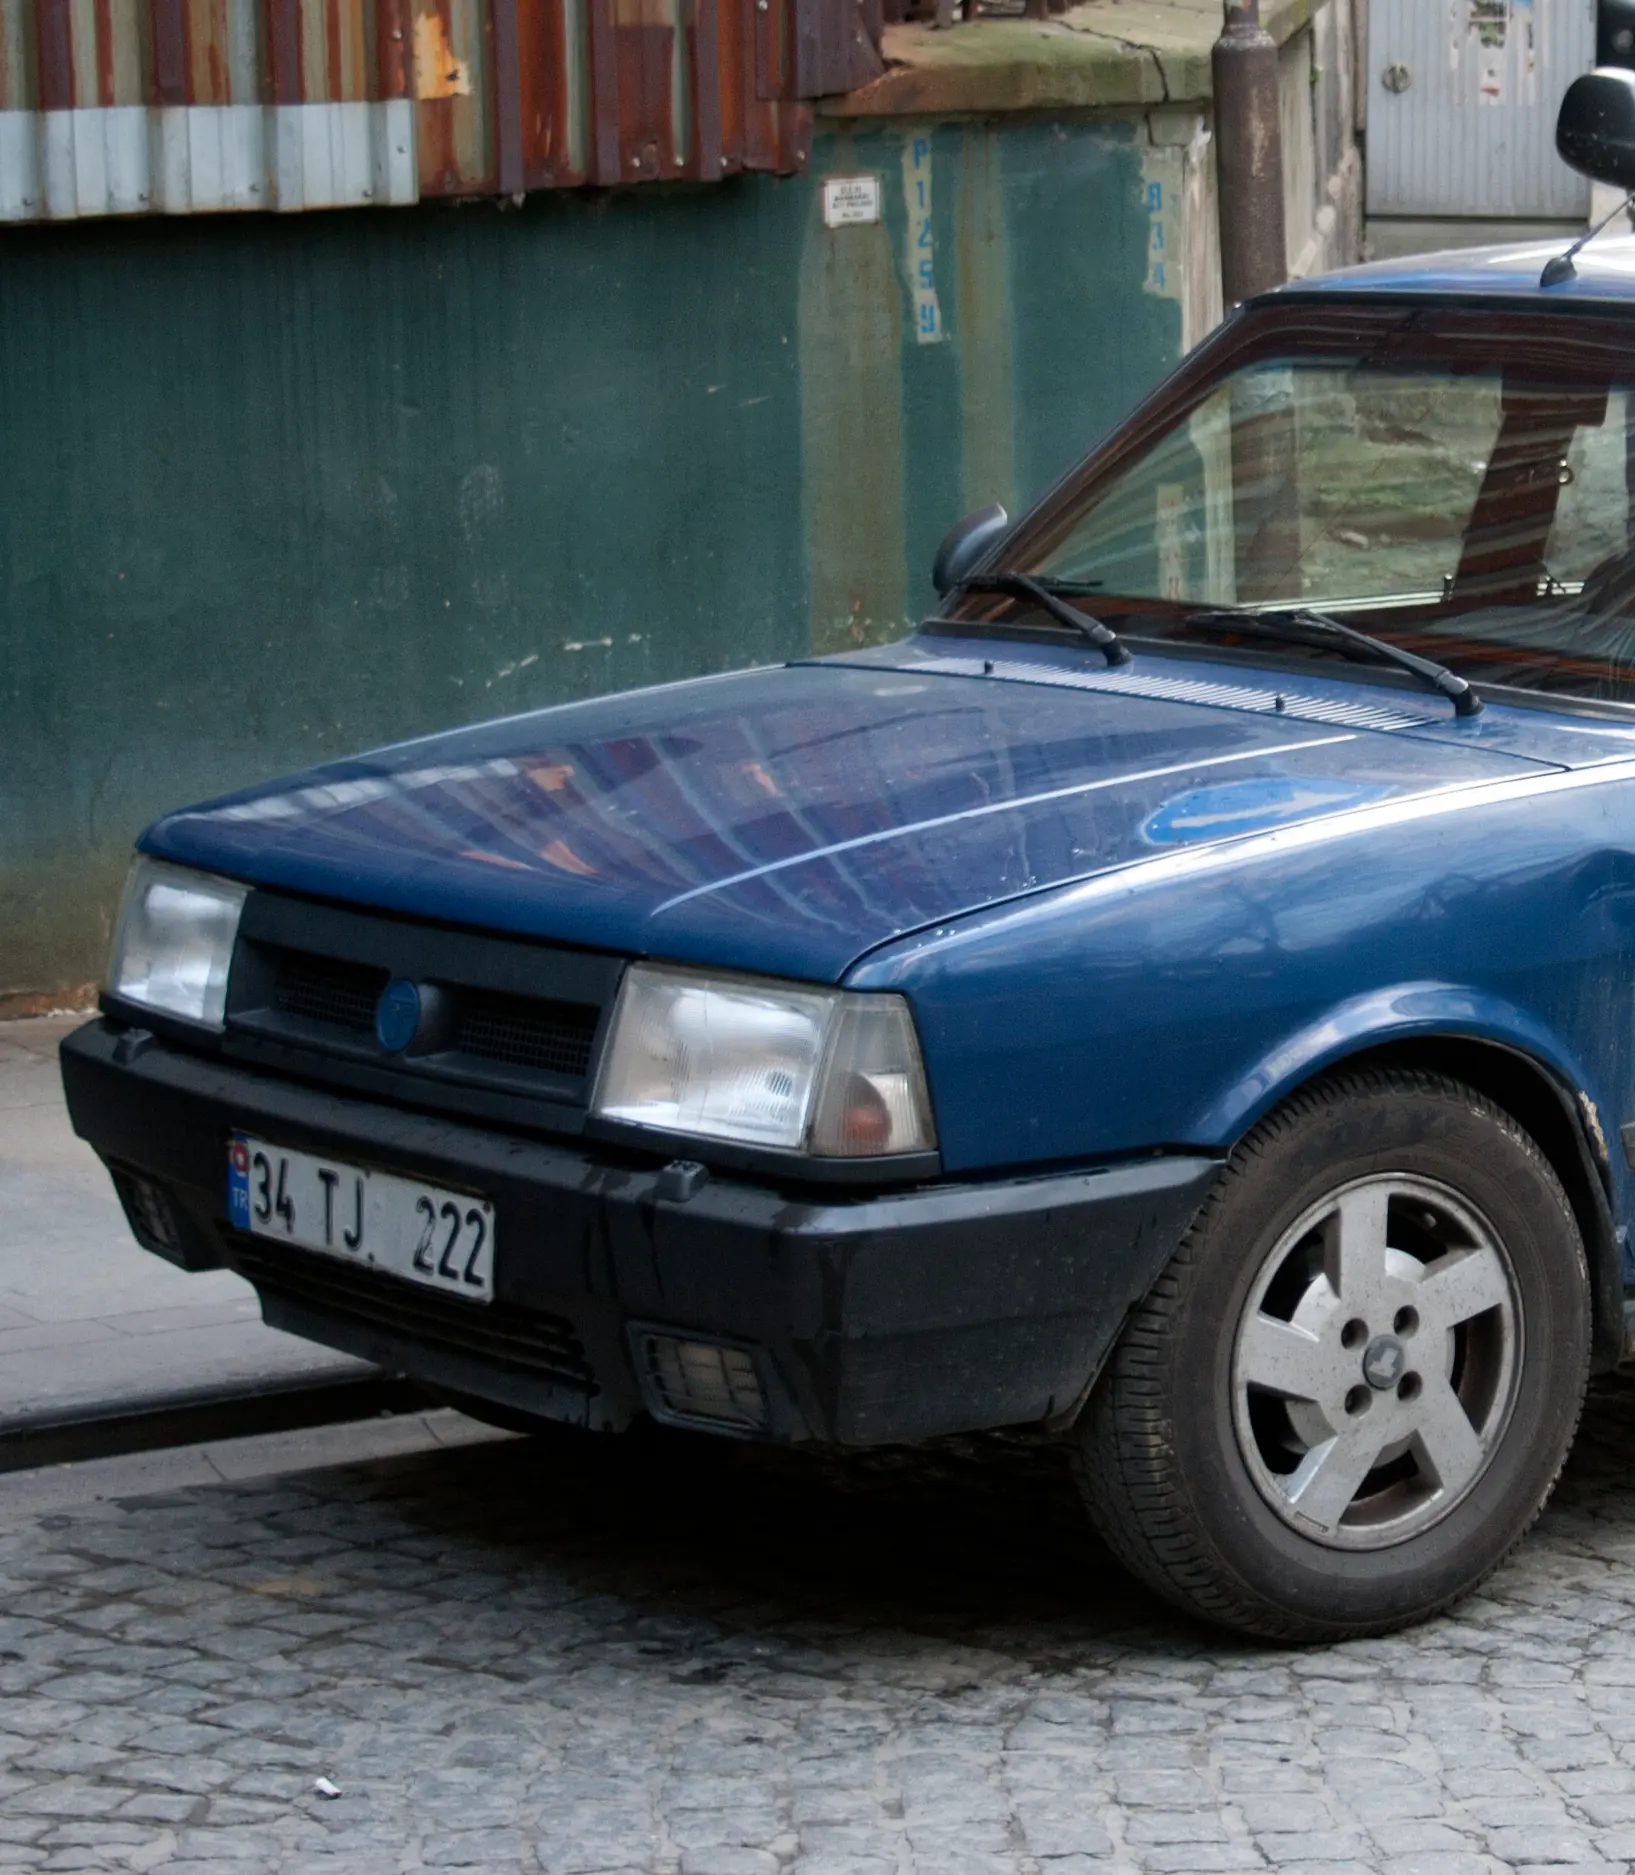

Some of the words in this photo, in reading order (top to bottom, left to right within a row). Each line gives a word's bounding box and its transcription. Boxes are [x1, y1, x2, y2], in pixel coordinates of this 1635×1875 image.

[232, 1186, 249, 1211] TR
[253, 1151, 295, 1234] 34
[318, 1168, 364, 1251] TJ
[413, 1196, 487, 1288] 222
